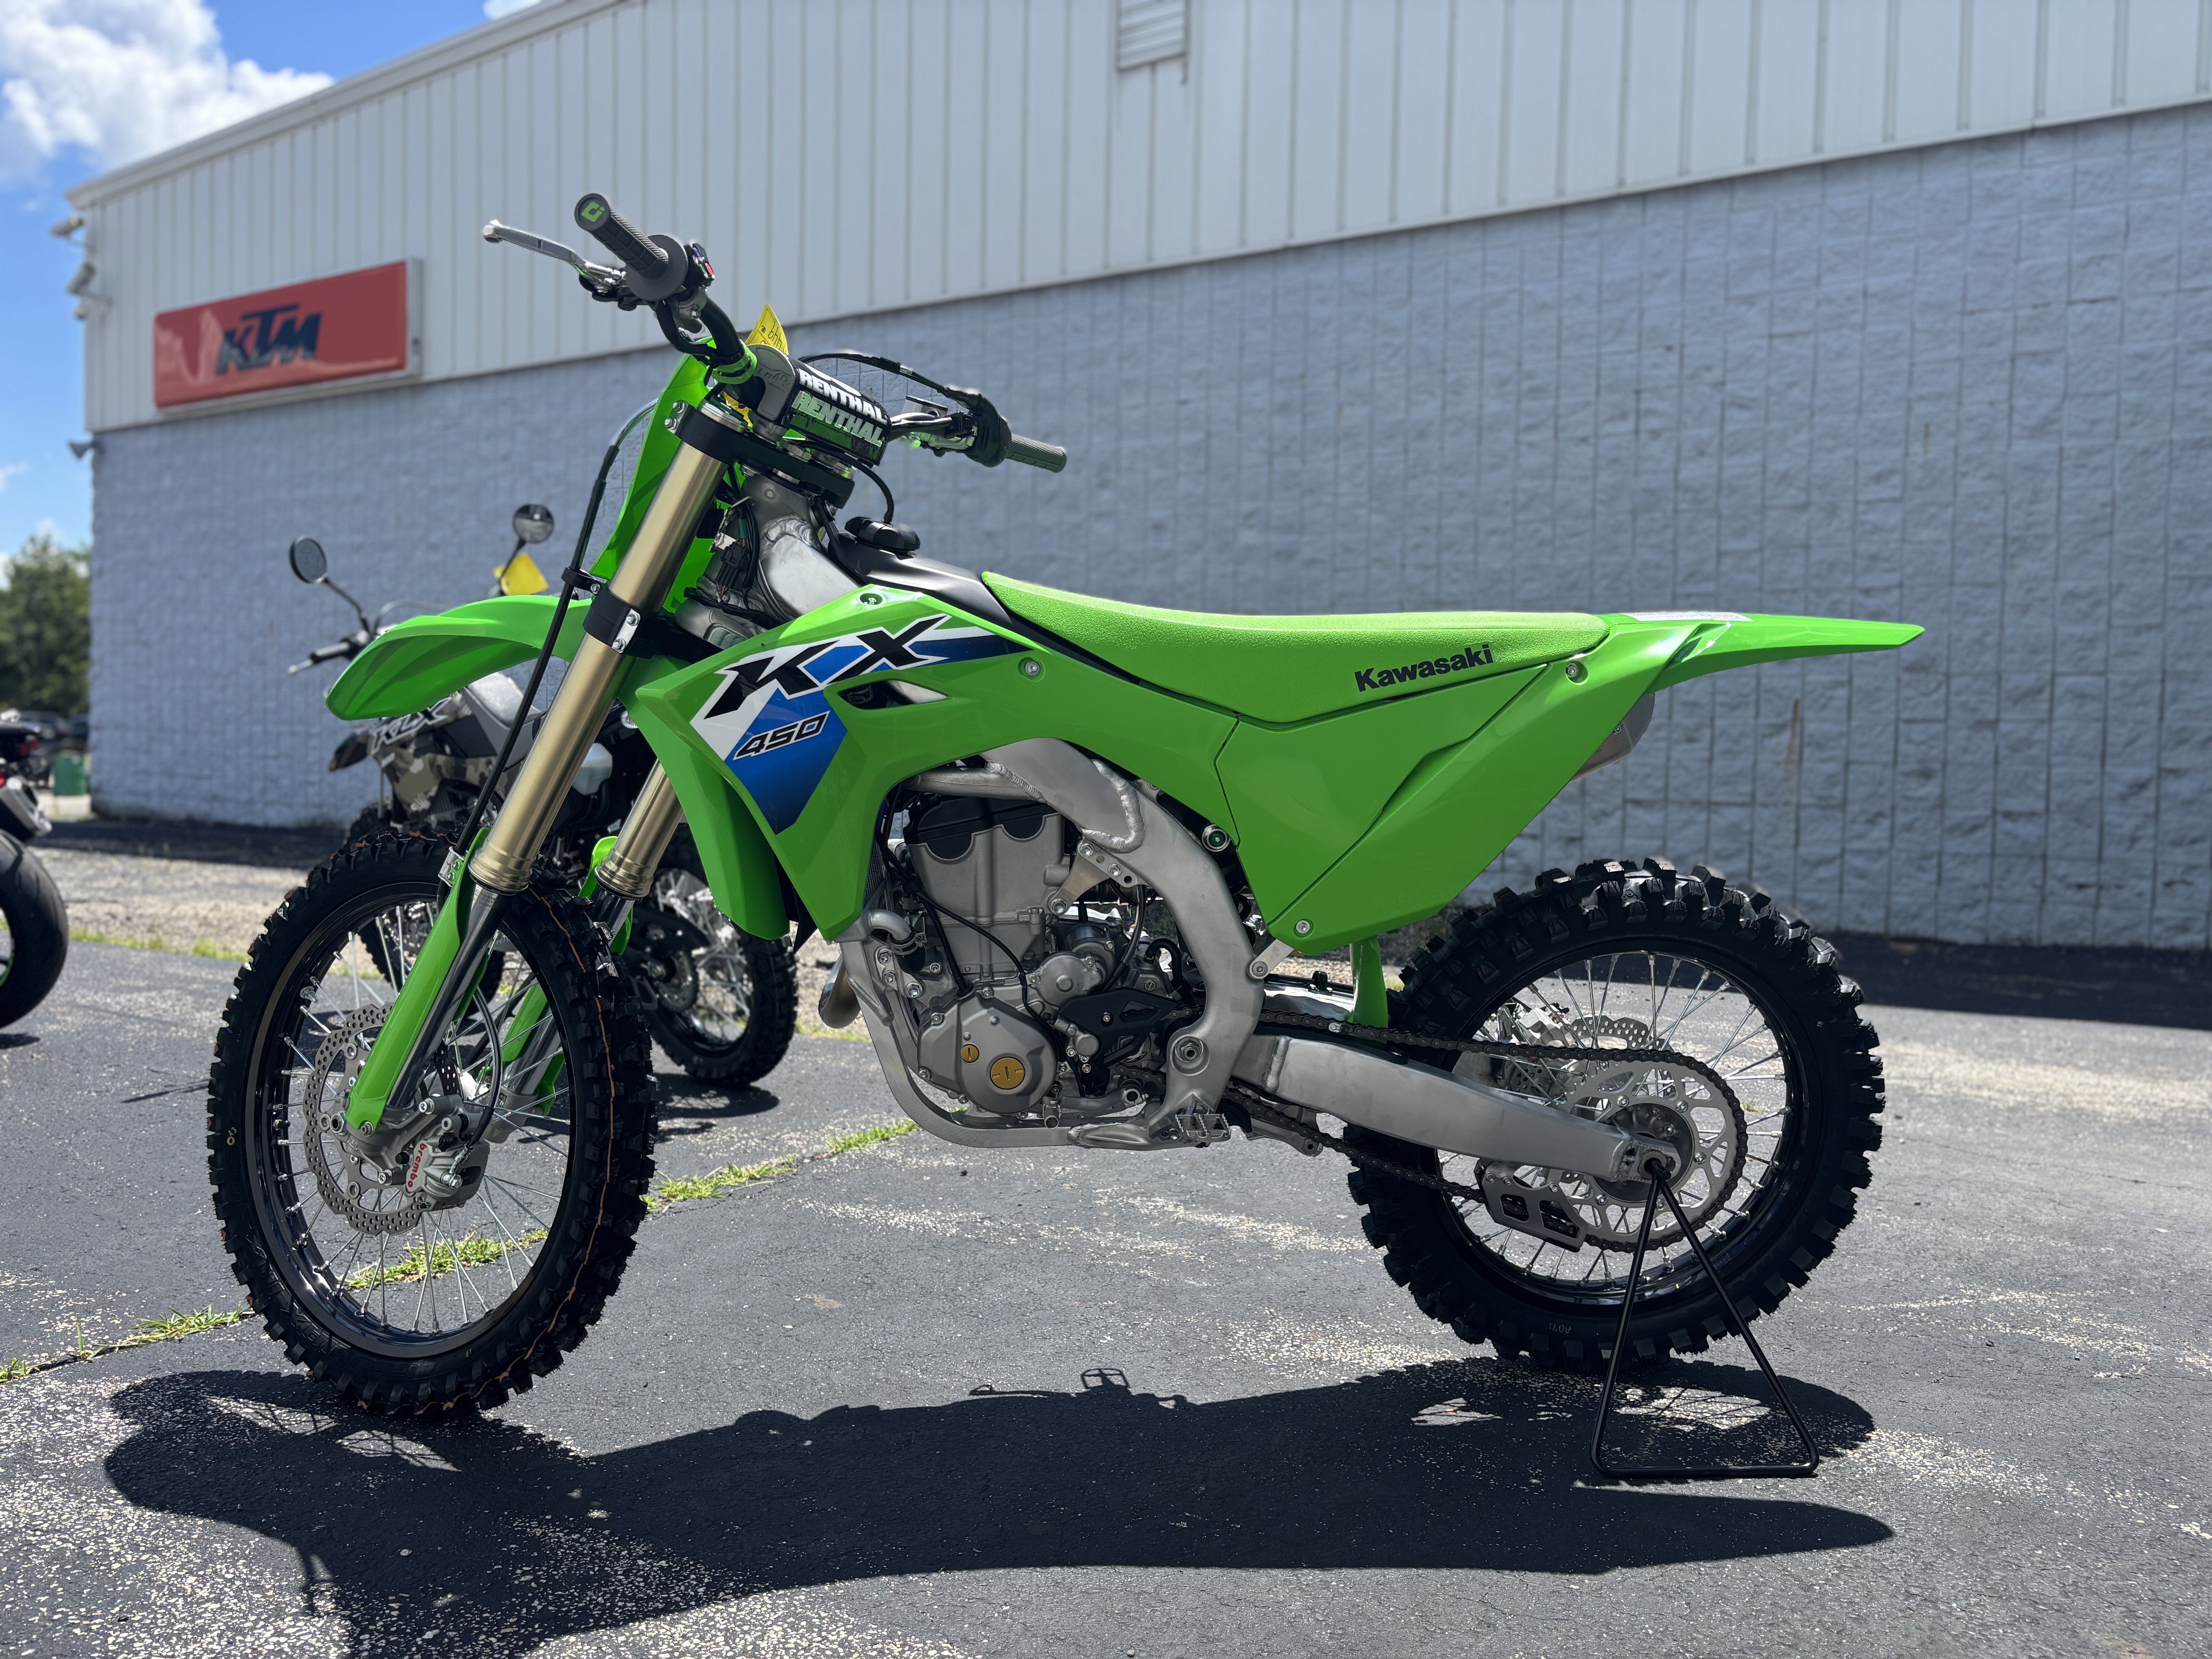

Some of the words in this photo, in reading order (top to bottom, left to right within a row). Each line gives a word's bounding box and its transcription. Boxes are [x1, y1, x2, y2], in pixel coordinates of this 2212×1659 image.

[215, 302, 323, 376] KTM
[792, 390, 882, 447] RENTHAL
[799, 368, 888, 426] RENTHAL
[704, 614, 947, 720] KX
[1355, 644, 1494, 692] Kawasaki
[735, 713, 828, 759] 450
[407, 1143, 428, 1188] brembo
